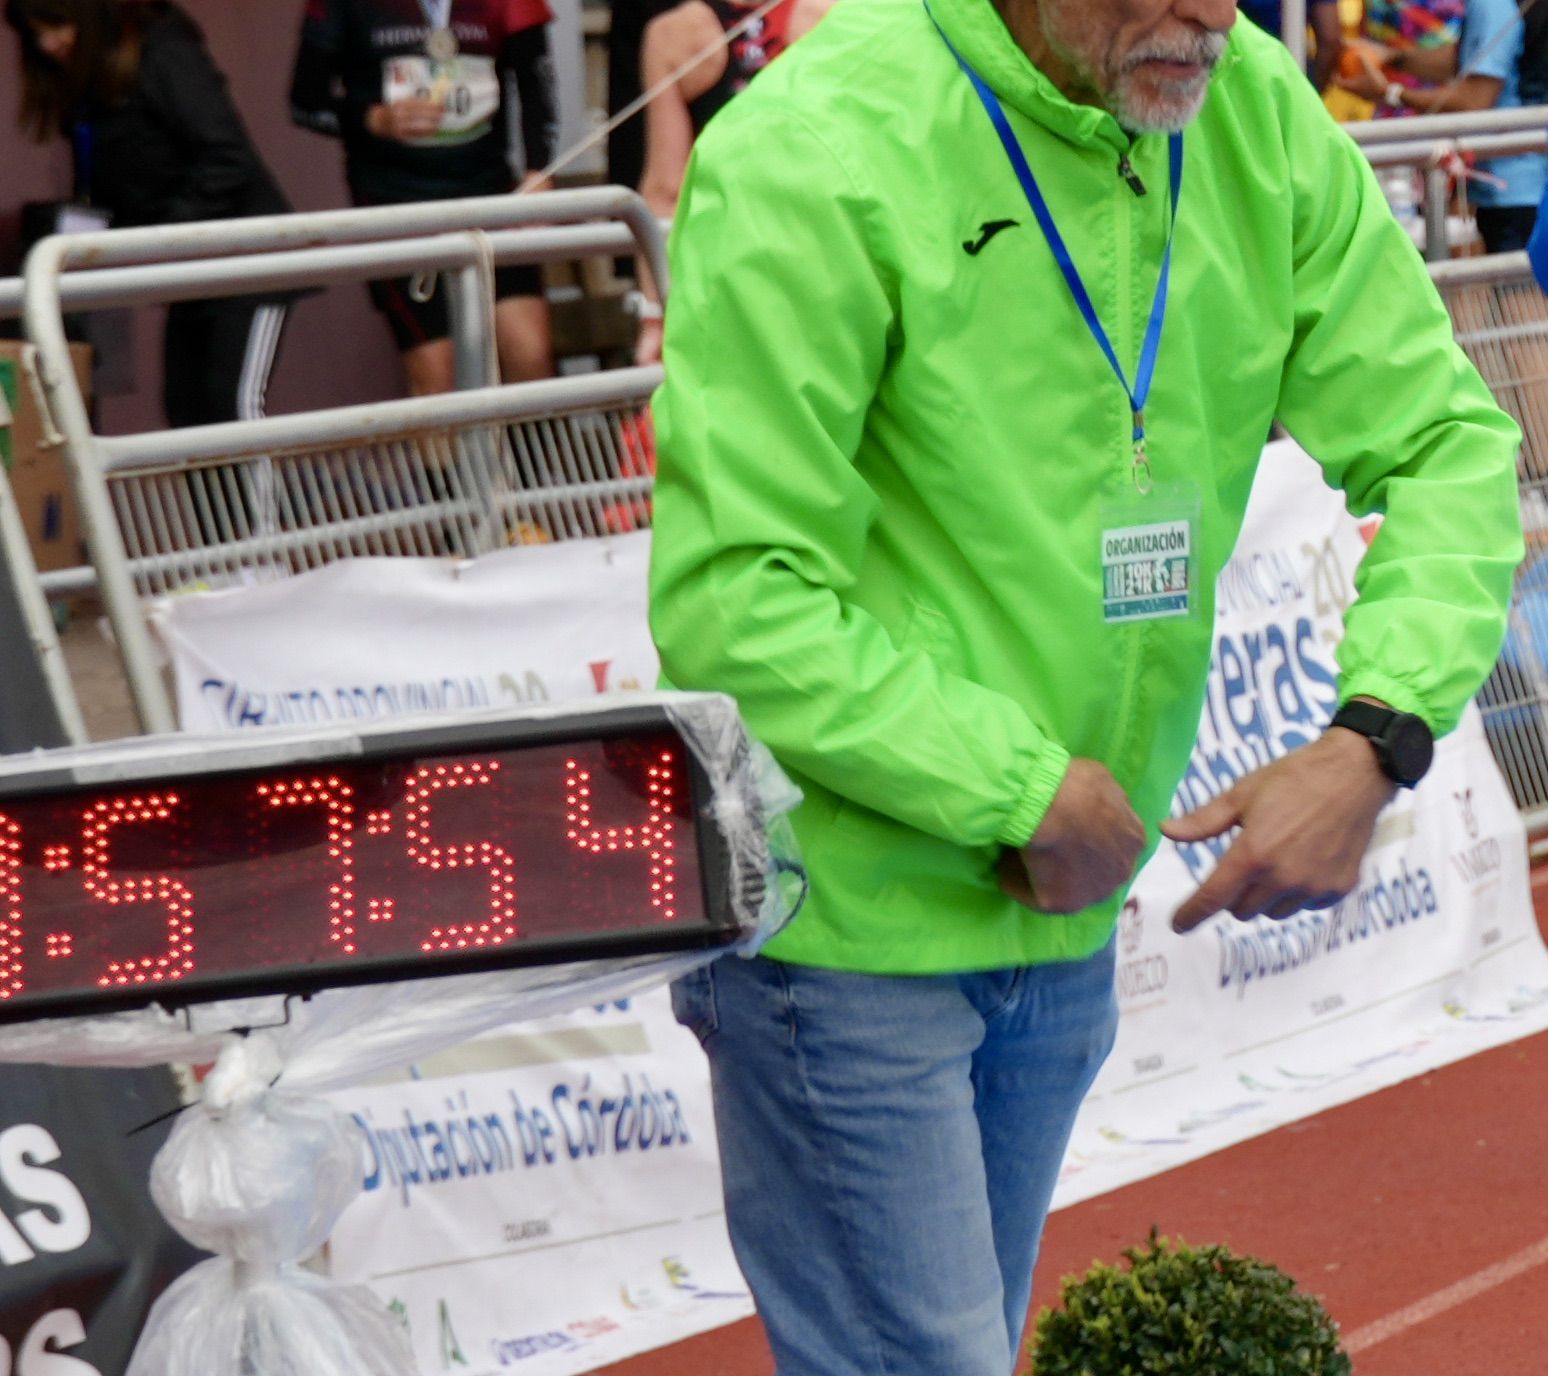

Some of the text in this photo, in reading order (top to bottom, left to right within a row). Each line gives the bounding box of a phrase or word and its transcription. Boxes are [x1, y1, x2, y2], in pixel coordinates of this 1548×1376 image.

[1105, 526, 1185, 558] ORGANIZACIÓN
[353, 1072, 692, 1207] Diputación de Córdoba
